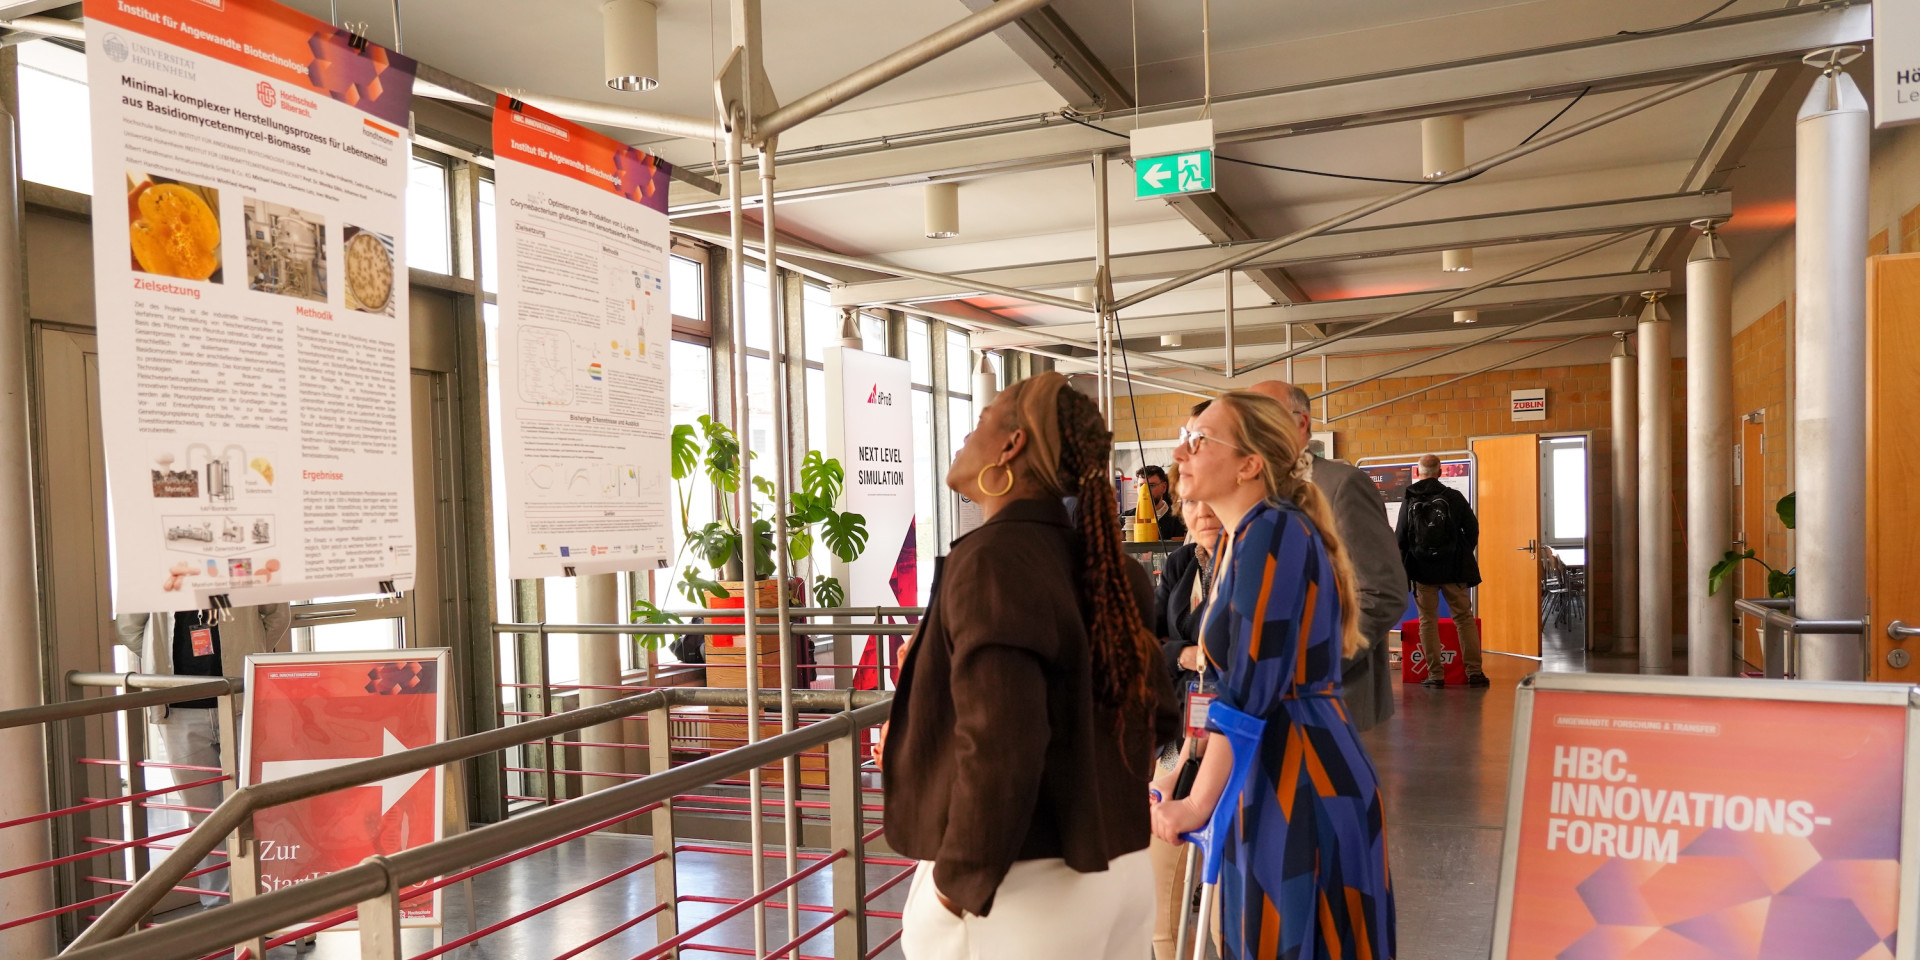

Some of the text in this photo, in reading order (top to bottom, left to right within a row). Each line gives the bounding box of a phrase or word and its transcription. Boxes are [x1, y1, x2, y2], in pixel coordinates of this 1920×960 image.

[118, 0, 309, 75] Institut für Angewandte Biotechnologie
[132, 55, 196, 81] HOHENHEIM
[280, 90, 317, 110] Hochschule
[1898, 90, 1919, 104] Le
[281, 101, 311, 118] Biberach.
[121, 75, 388, 166] Minimal-komplexer Herstellungsprozess für Lebensmittel
[122, 95, 311, 155] aus Basidiomycetenmycel-Biomasse
[363, 127, 393, 146] handtmann
[511, 139, 622, 185] Institut für Angewandte Biotechnologie
[510, 198, 558, 217] Corynebacterium
[559, 212, 587, 226] glutamicum
[548, 198, 580, 215] Optimierung
[589, 210, 611, 224] Produktion
[516, 223, 546, 238] Zielsetzung
[134, 278, 200, 299] Zielsetzung
[296, 306, 333, 321] Methodik
[878, 392, 892, 406] dProB
[570, 414, 591, 424] Bisherige
[592, 416, 617, 424] Erkenntnisse
[859, 446, 902, 463] NEXT LEVEL
[302, 470, 343, 482] Ergebnisse
[859, 470, 904, 486] SIMULATION
[1557, 717, 1716, 733] ANGEWANDTE FORSCHUNG & TRANSFER
[1553, 745, 1637, 783] HBC.
[1550, 781, 1831, 838] INNOVATIONS-
[260, 840, 300, 861] Zur
[1547, 818, 1679, 863] FORUM
